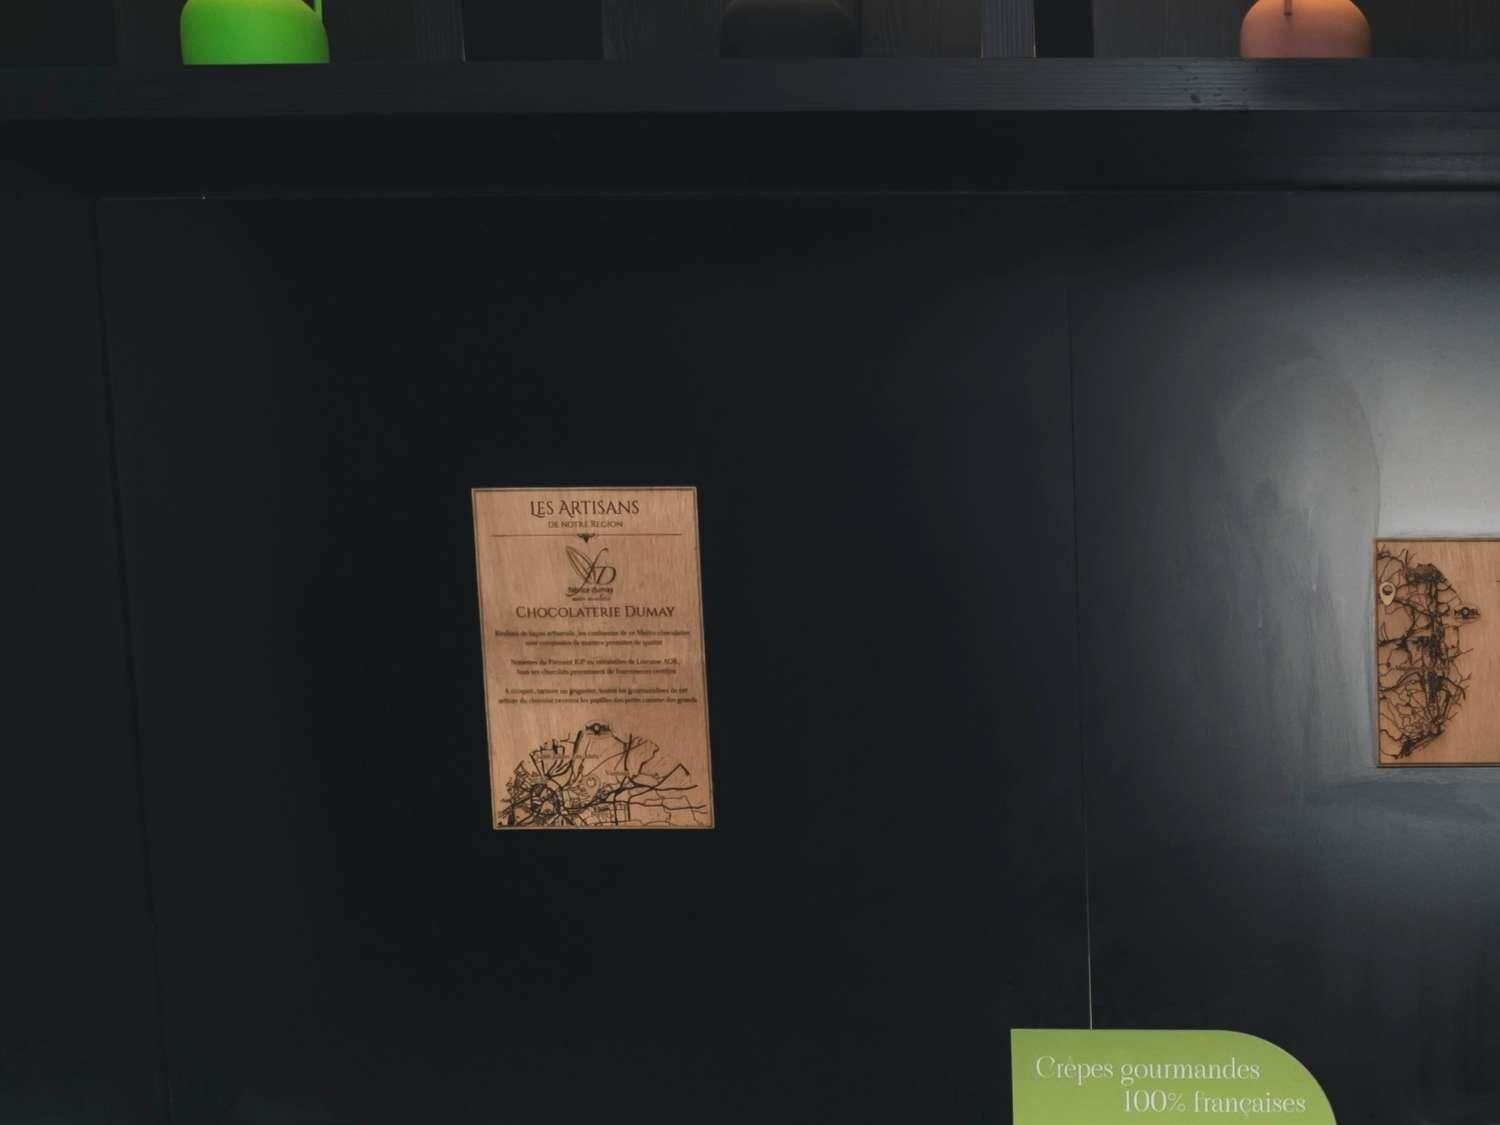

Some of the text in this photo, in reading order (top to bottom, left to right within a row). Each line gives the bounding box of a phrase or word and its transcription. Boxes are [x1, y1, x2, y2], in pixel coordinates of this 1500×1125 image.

[530, 500, 640, 518] LES ARTISANS
[548, 520, 559, 528] DE
[561, 520, 587, 528] NOTRE
[515, 605, 676, 618] CHOCOLATERIE DUMAY
[1036, 1055, 1260, 1086] Crêpes gourmandes
[1123, 1089, 1307, 1119] 100% françaises
